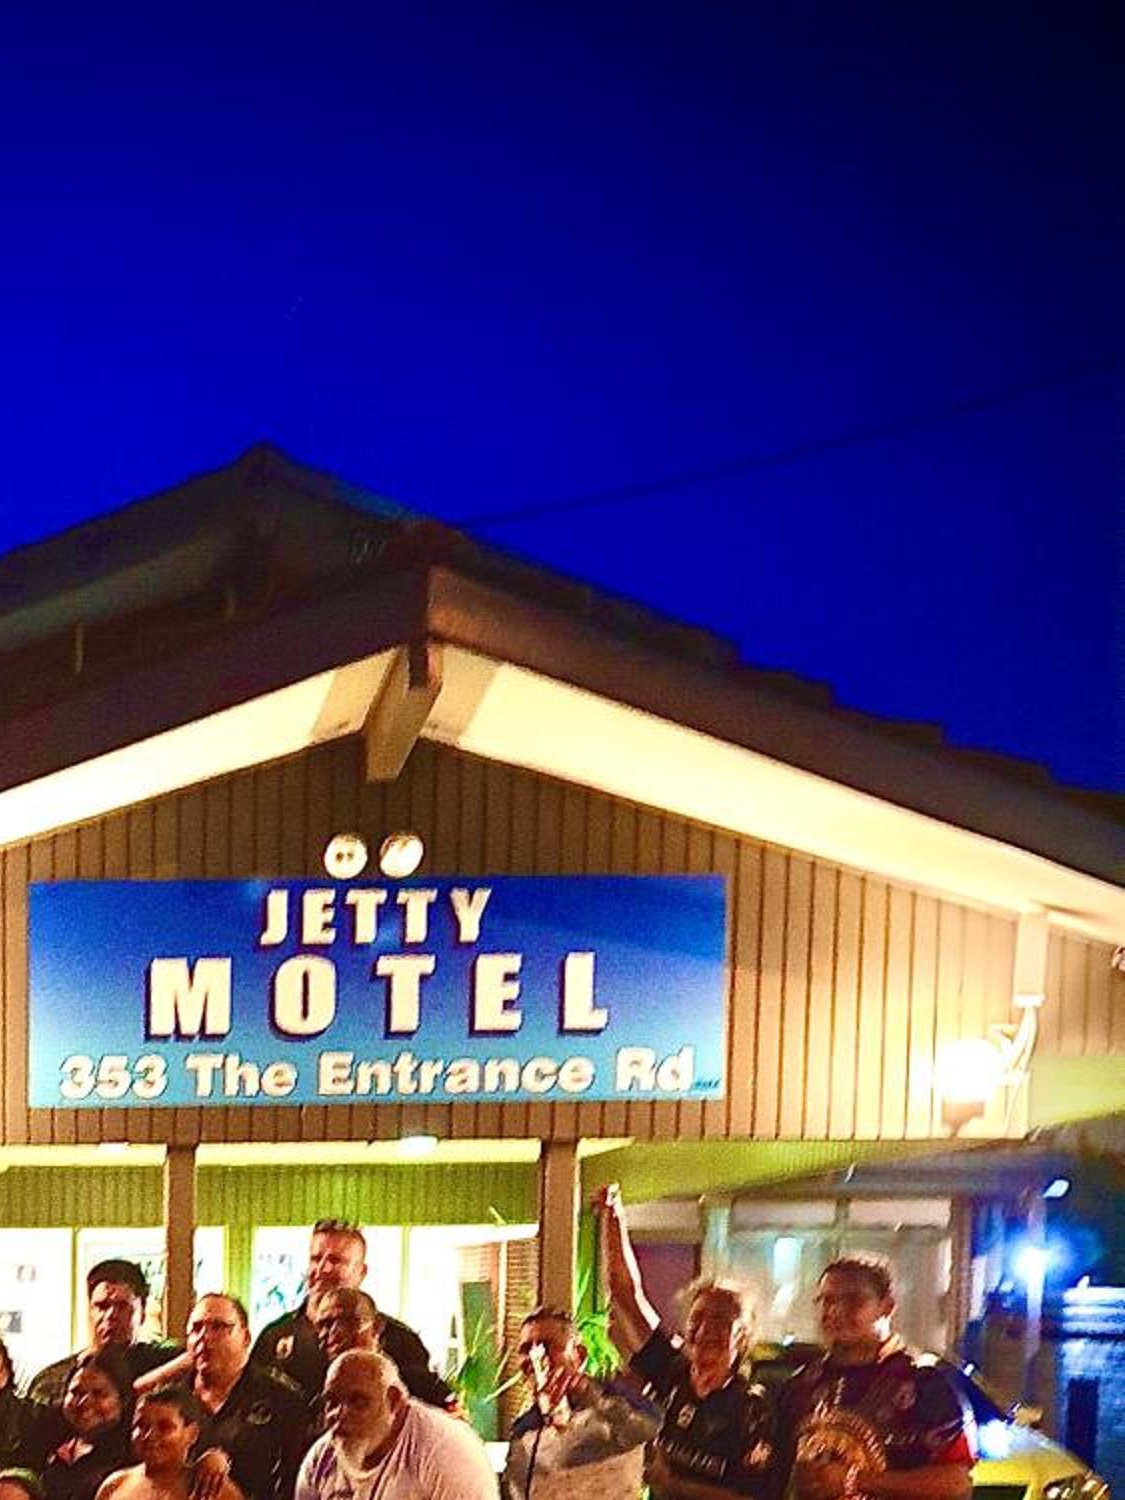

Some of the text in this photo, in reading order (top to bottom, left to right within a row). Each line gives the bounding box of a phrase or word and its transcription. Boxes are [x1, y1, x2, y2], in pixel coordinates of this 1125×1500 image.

[261, 887, 492, 945] JETTY
[146, 952, 609, 1040] MOTEL
[59, 1045, 695, 1099] 353 The Entrance Rd
